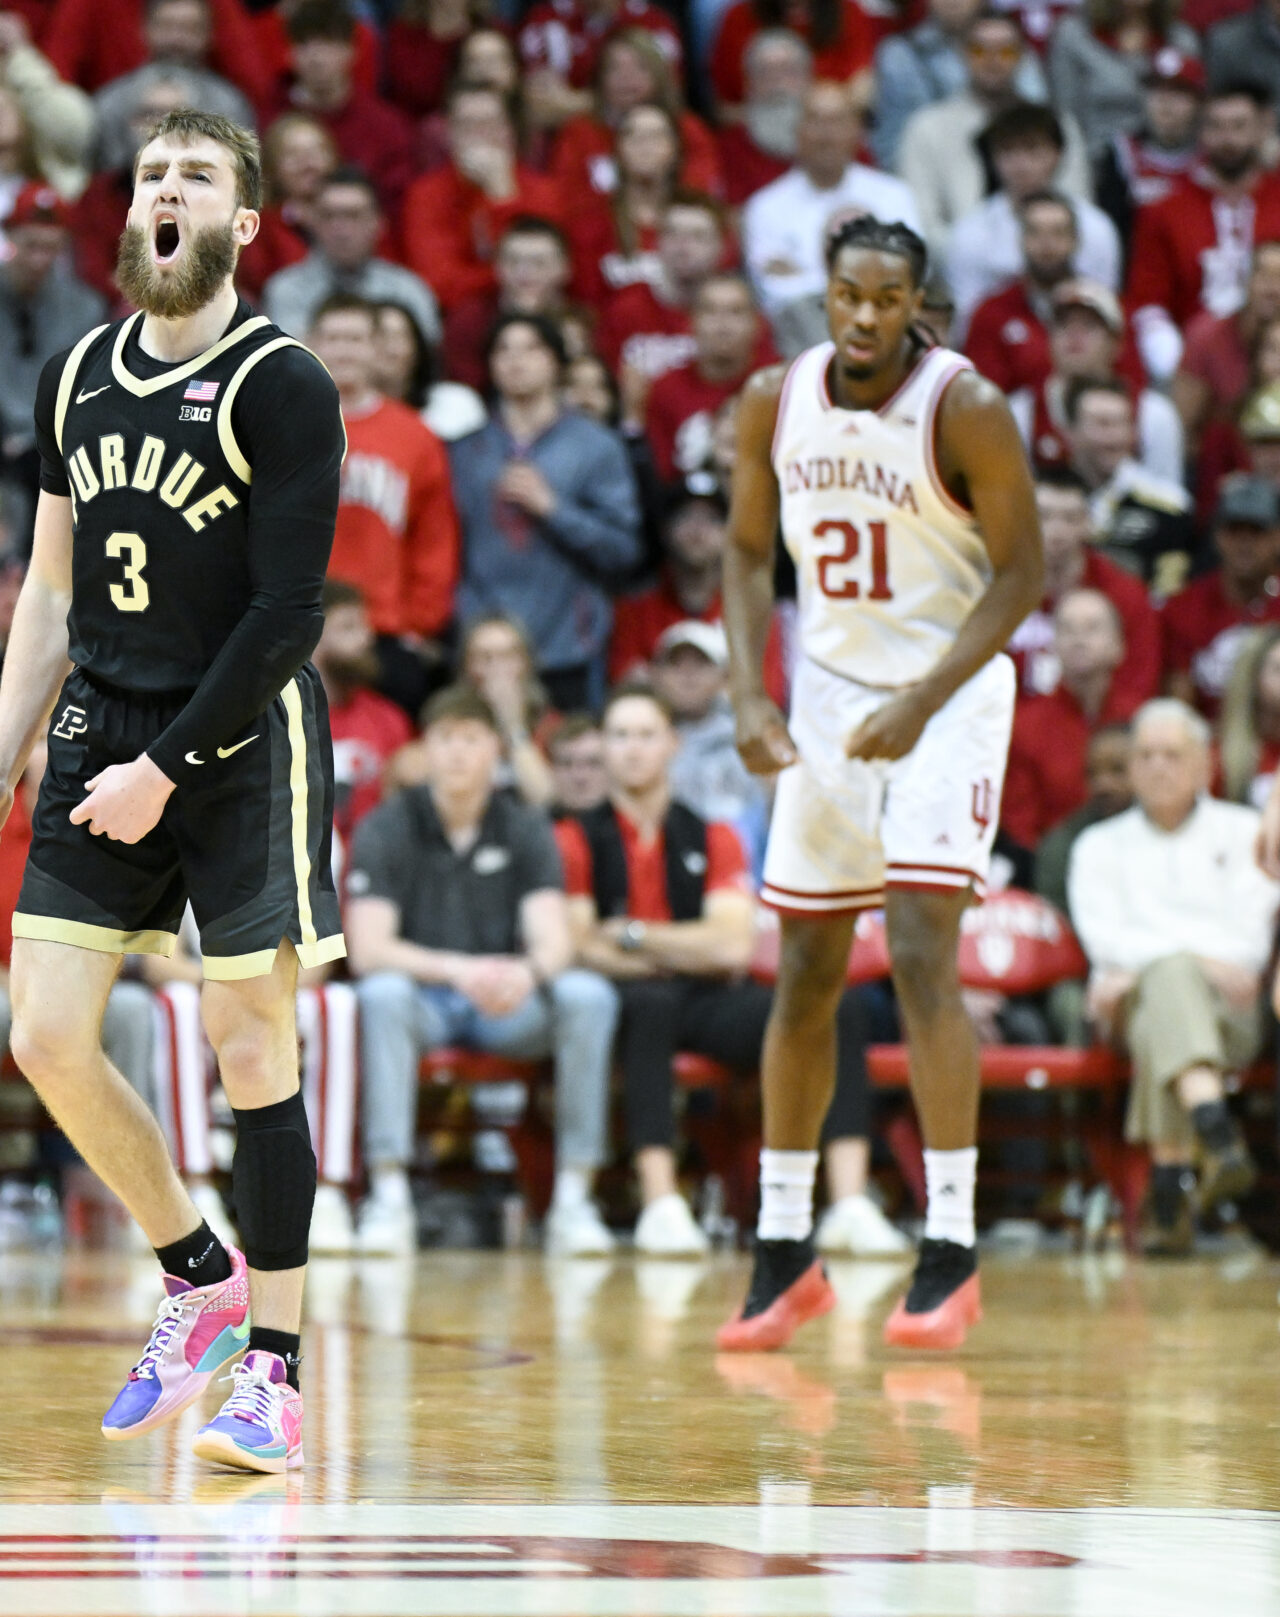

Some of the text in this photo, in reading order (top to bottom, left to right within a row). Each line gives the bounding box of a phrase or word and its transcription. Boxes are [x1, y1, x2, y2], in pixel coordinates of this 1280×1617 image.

[784, 455, 920, 516] INDIANA
[104, 531, 151, 614] 3
[812, 520, 894, 600] 21
[51, 703, 89, 741] P
